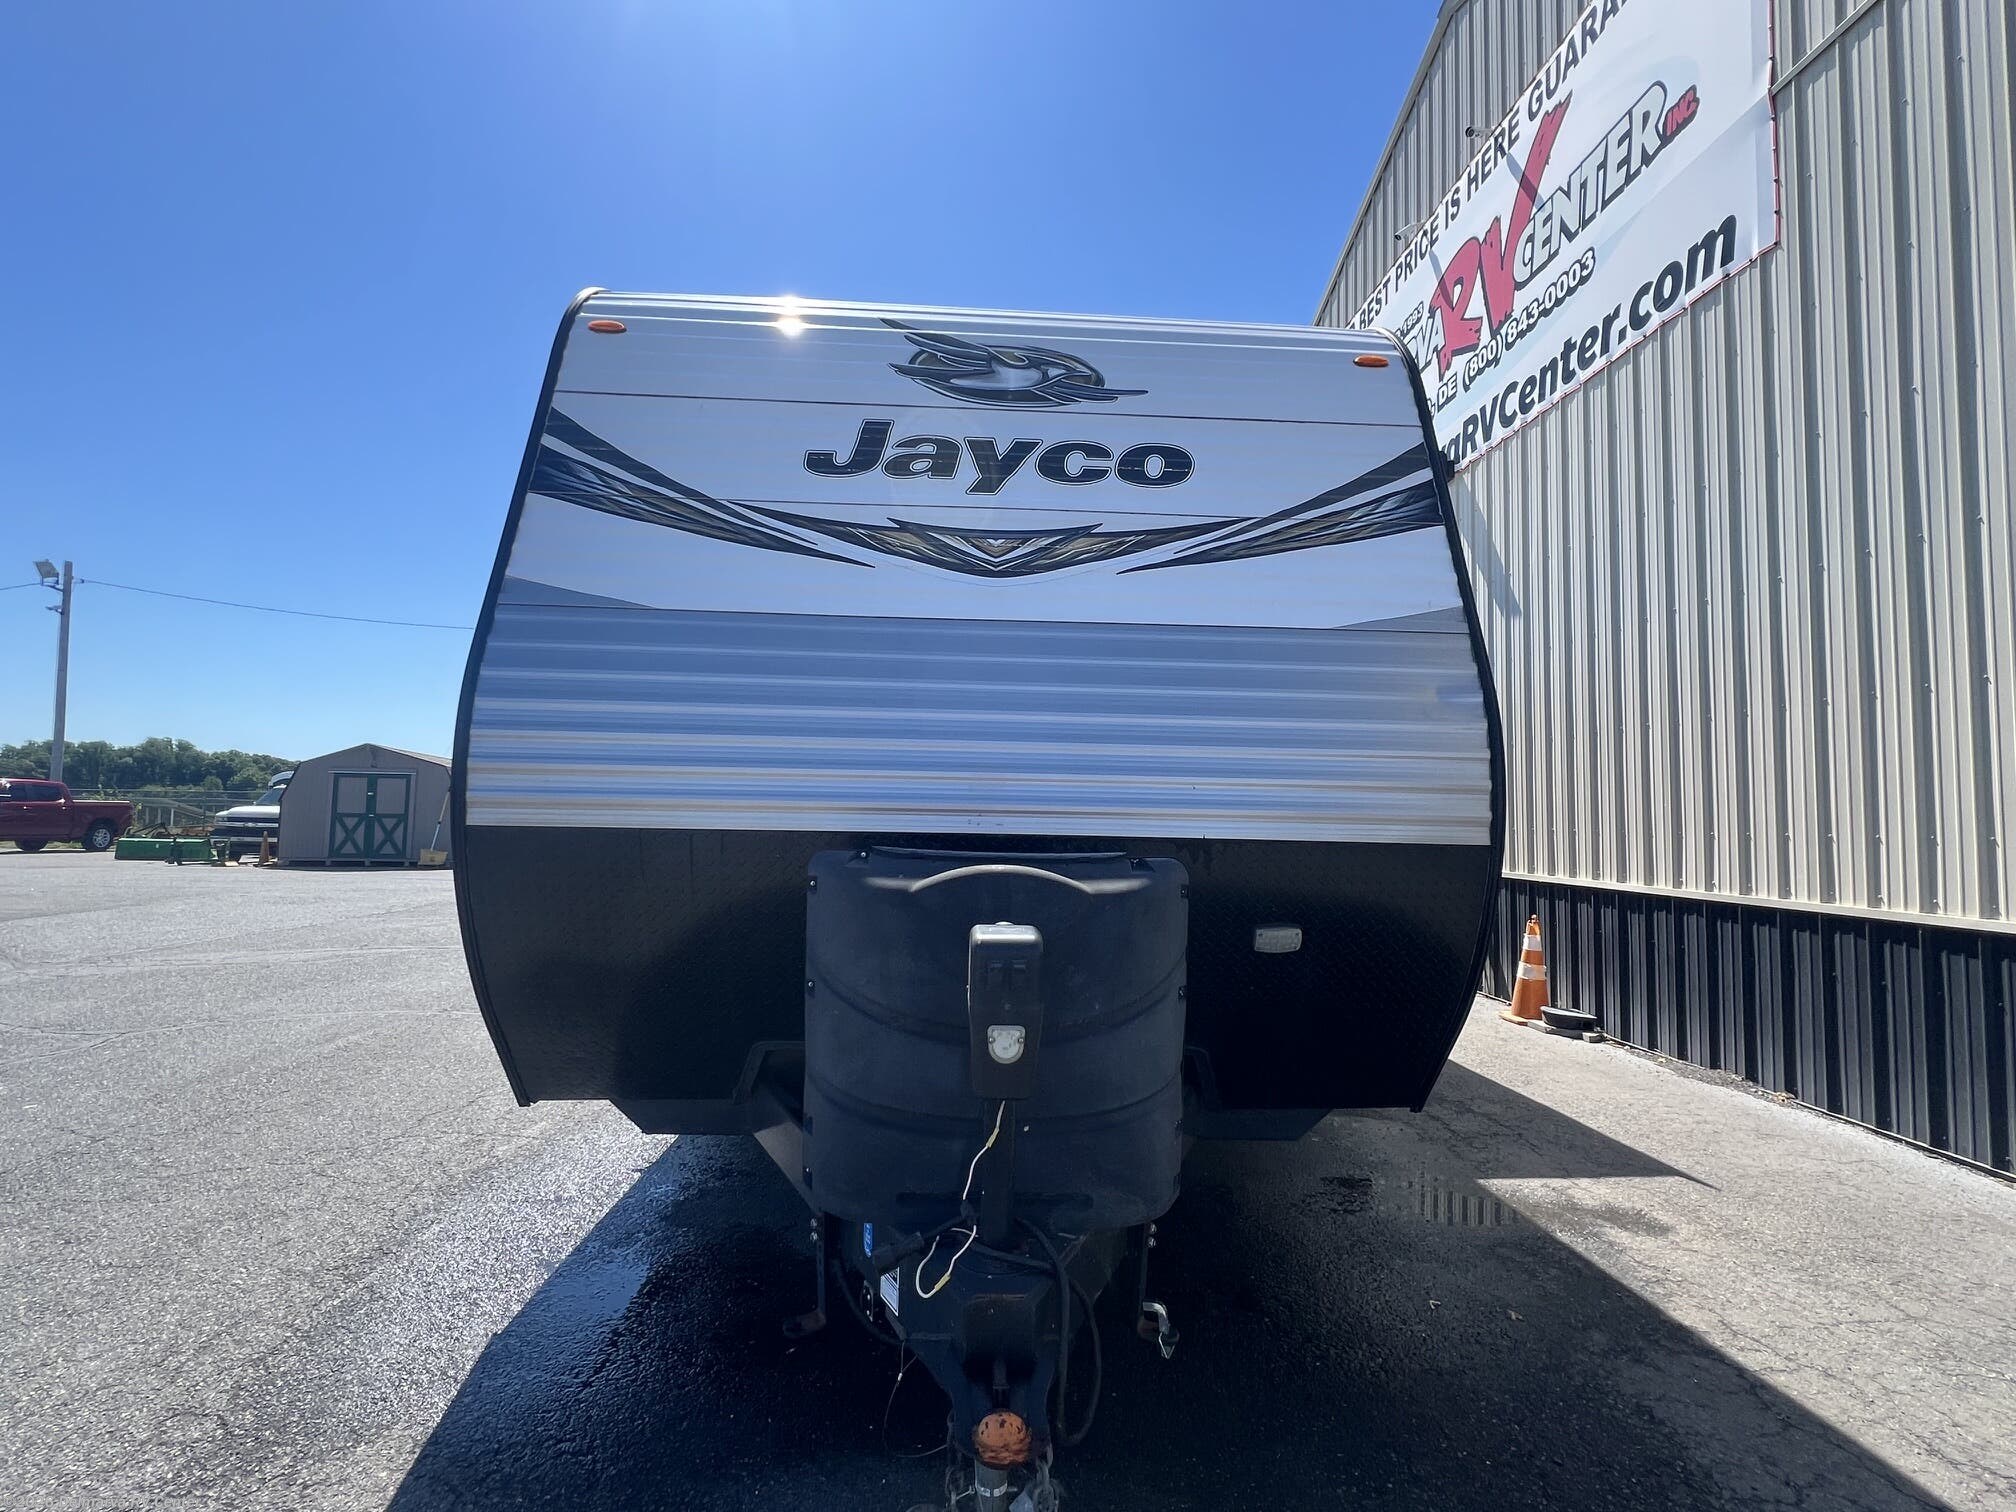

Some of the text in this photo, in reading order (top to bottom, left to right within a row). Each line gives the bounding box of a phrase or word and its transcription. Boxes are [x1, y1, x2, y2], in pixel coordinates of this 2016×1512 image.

[1360, 0, 1628, 330] BEST PRICE IS HERE GUARA
[1428, 89, 1573, 381] RV
[1513, 80, 1670, 291] CENTER
[1402, 300, 1424, 336] 1993
[1437, 246, 1596, 412] DE (800) 843-0003
[1441, 214, 1737, 464] aRVCenter.com
[803, 418, 1196, 496] Jayco
